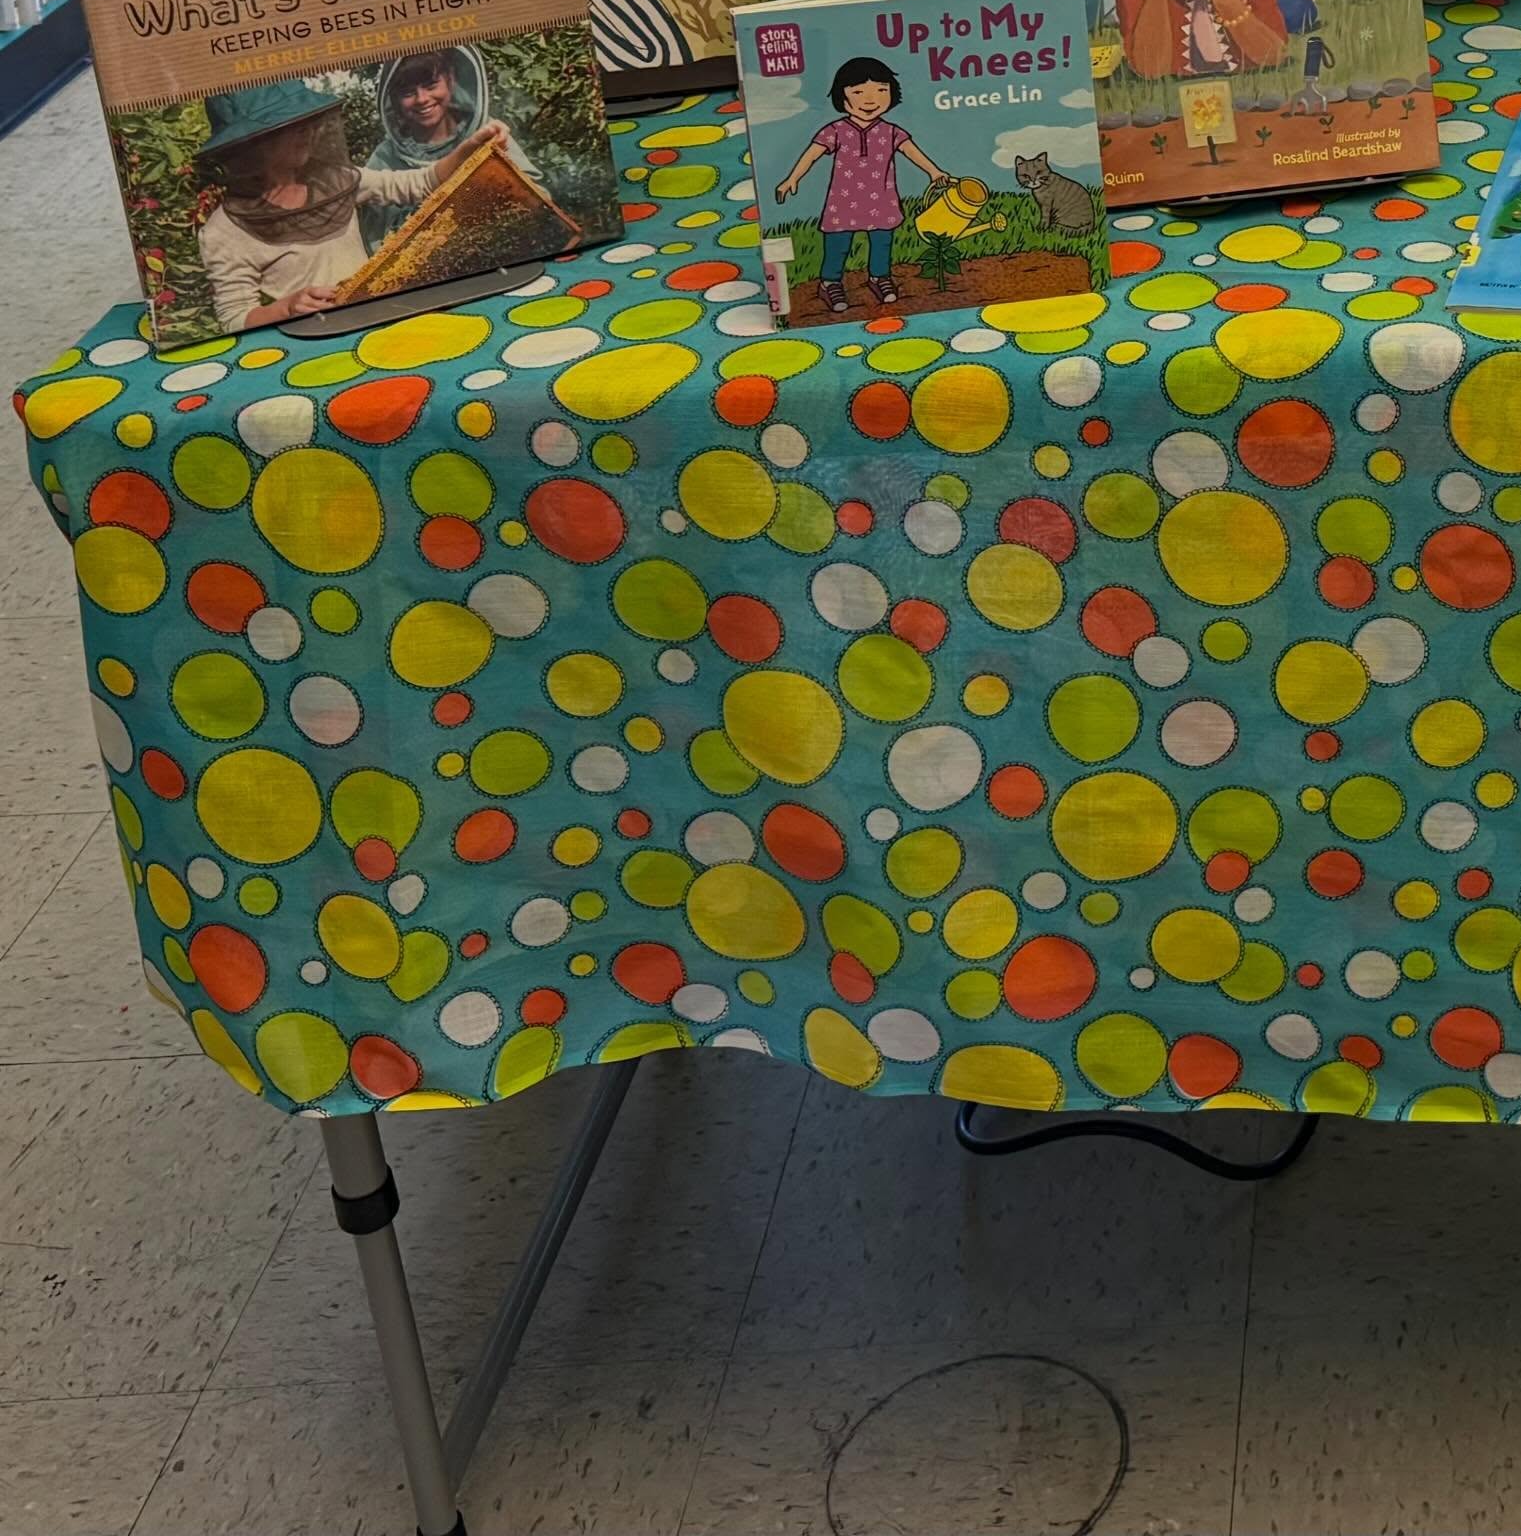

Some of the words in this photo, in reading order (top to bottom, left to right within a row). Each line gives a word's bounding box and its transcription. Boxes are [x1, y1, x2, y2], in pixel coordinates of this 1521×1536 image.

[210, 19, 312, 56] KEEPING
[319, 7, 376, 35] BEES
[383, 0, 408, 22] IN
[760, 26, 798, 43] story
[876, 12, 930, 54] Up
[939, 12, 972, 39] to
[980, 2, 1045, 42] My
[232, 45, 317, 76] MERRIE
[326, 29, 390, 58] ELLEN
[398, 13, 478, 43] WILCOX
[760, 40, 799, 57] telling
[766, 54, 799, 73] MATH
[928, 35, 1072, 82] Knees!
[934, 90, 1002, 111] Grace
[1007, 84, 1043, 105] Lin
[1388, 128, 1401, 139] by
[1273, 148, 1329, 166] Rosalind
[1332, 141, 1402, 160] Beardshaw
